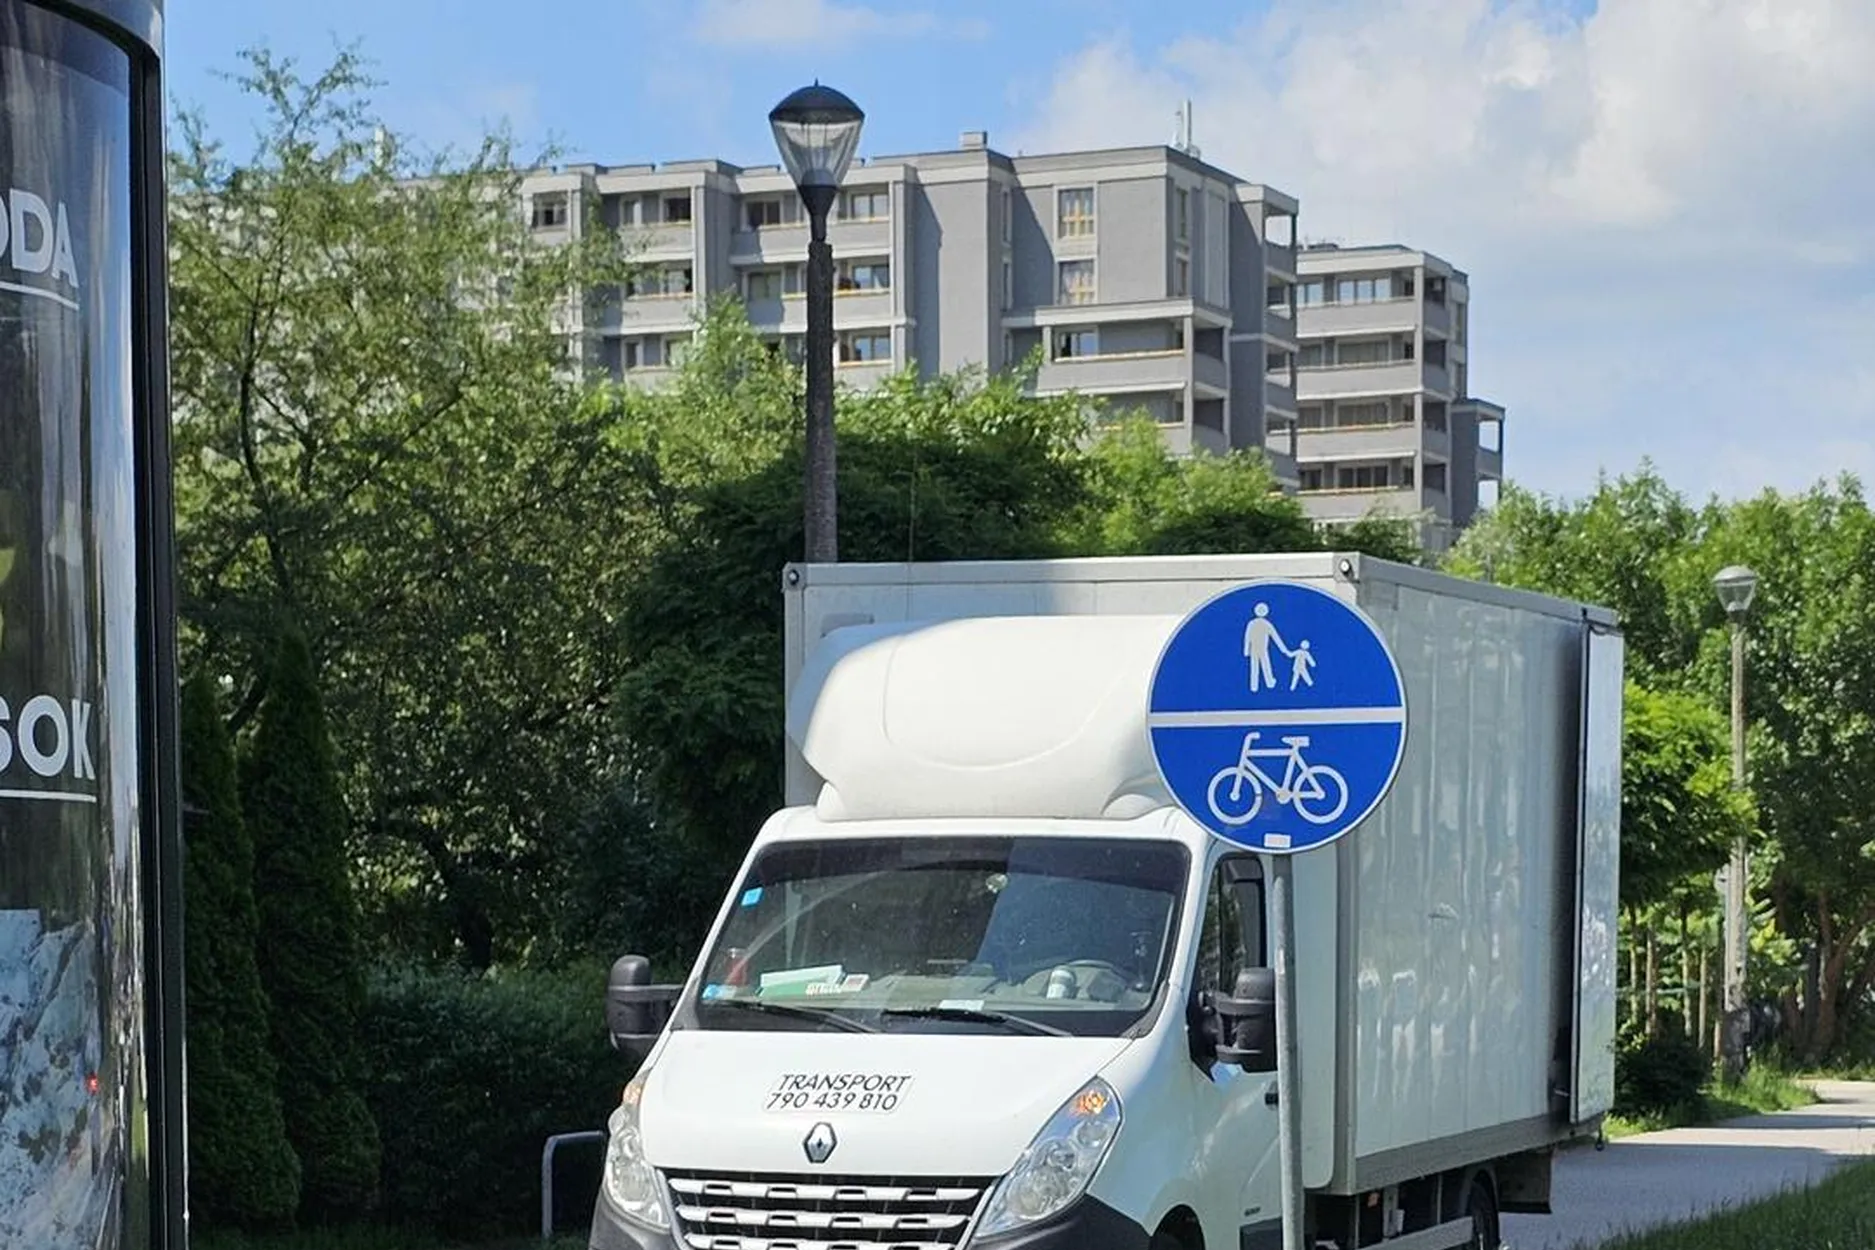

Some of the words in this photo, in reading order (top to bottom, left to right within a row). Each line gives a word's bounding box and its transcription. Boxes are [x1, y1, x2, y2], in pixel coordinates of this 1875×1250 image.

[0, 188, 79, 288] DA
[779, 1073, 912, 1092] TRANSPORT
[766, 1092, 809, 1109] 790
[813, 1092, 857, 1109] 439
[859, 1093, 898, 1110] 810
